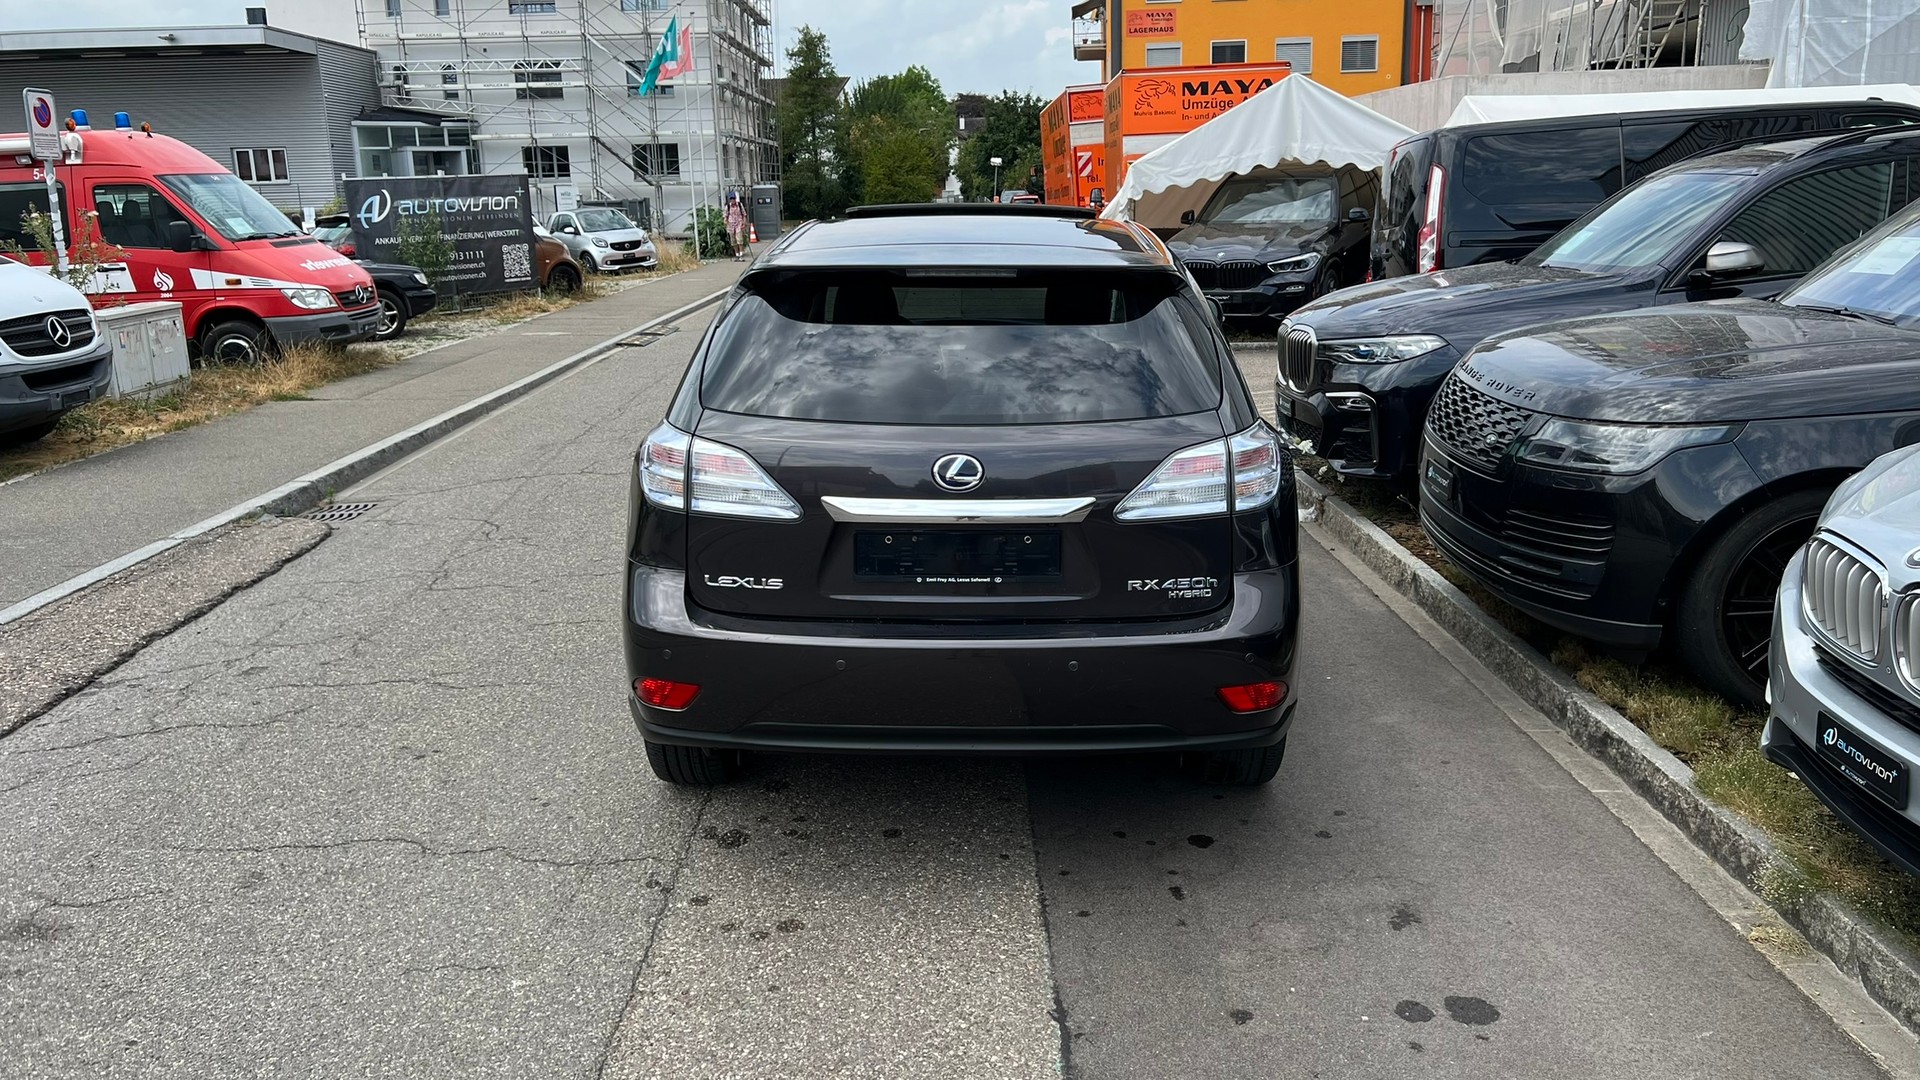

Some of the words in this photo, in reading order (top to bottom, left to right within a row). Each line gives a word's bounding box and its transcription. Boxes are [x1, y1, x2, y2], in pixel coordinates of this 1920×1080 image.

[1129, 26, 1174, 34] LAGERHAUS
[1182, 78, 1274, 97] MAYA
[1182, 98, 1234, 111] Umzüge
[1087, 174, 1101, 183] Tel.
[449, 252, 464, 261] 913
[1486, 379, 1537, 401] ROVER
[704, 574, 784, 590] LEXUS
[1127, 579, 1160, 591] RX
[1161, 576, 1218, 589] 450h
[1168, 588, 1212, 599] HYBRID
